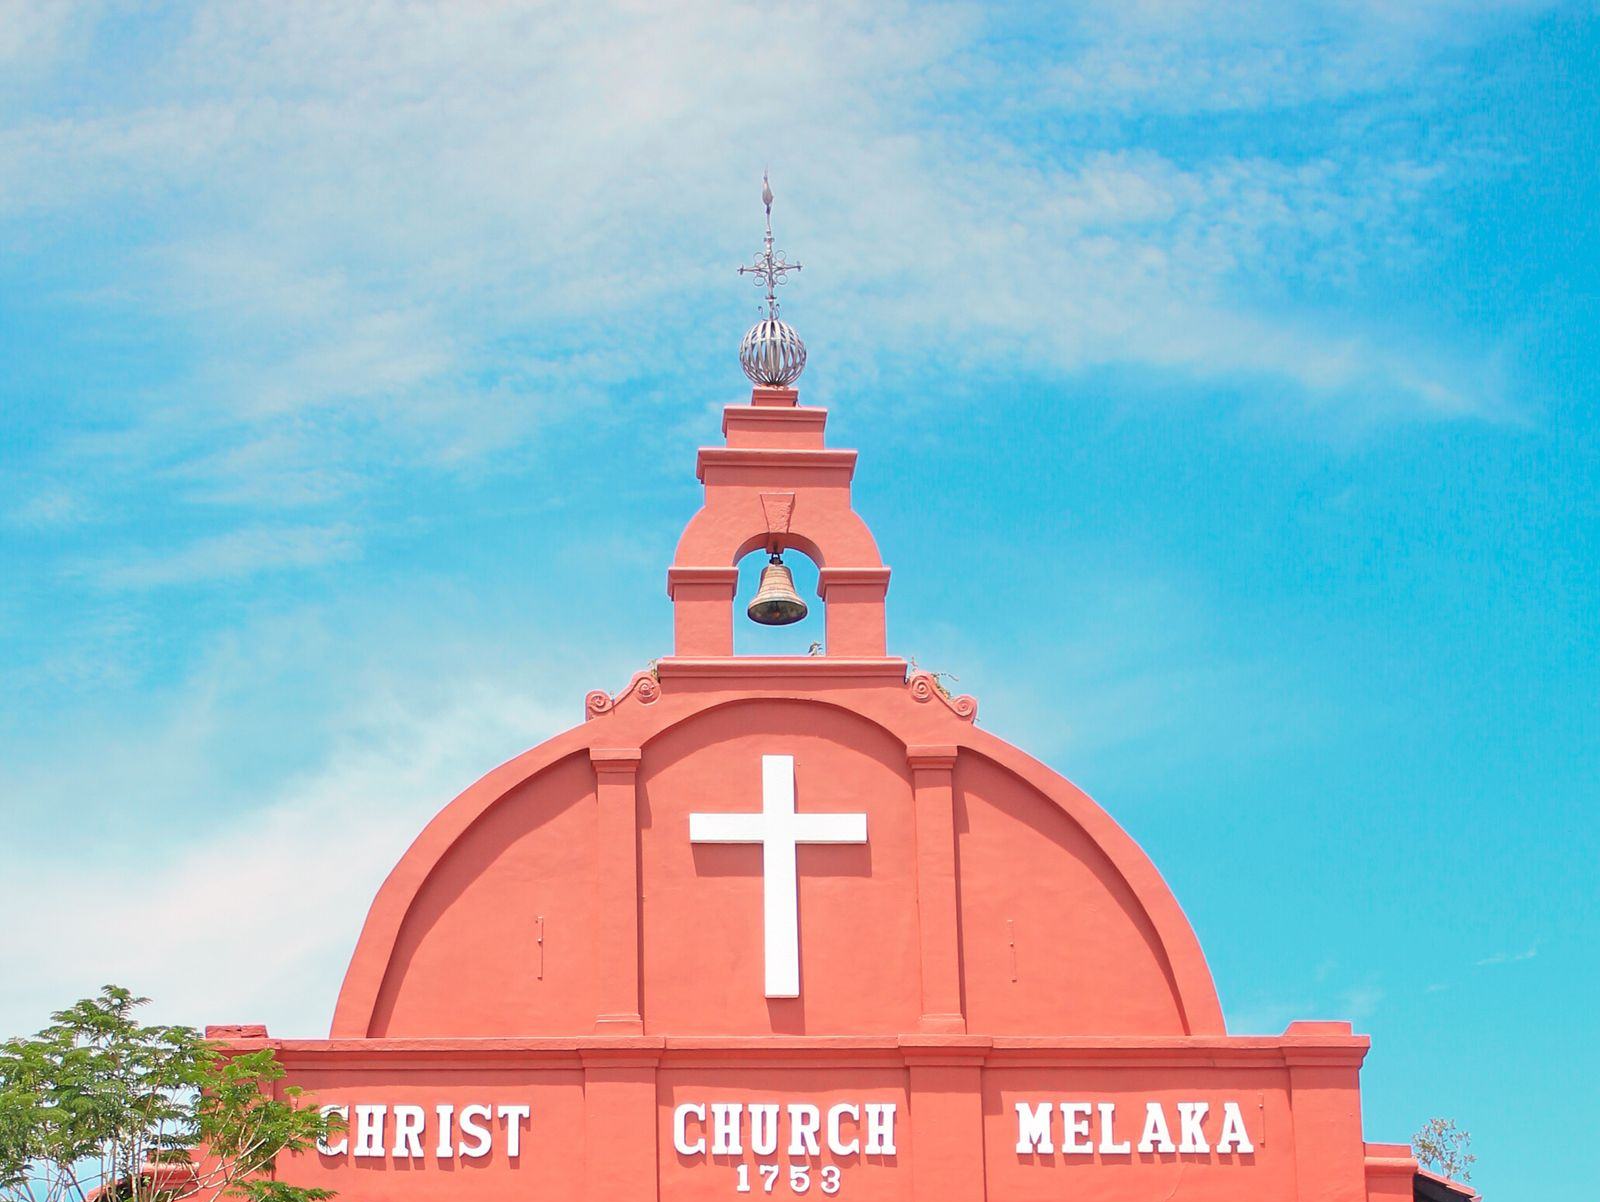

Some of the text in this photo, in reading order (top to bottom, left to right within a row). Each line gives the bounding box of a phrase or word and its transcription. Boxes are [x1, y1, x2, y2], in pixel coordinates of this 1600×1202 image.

[316, 1102, 1254, 1158] CHRIST CHURCH MELAKA
[736, 1164, 841, 1193] 1753
